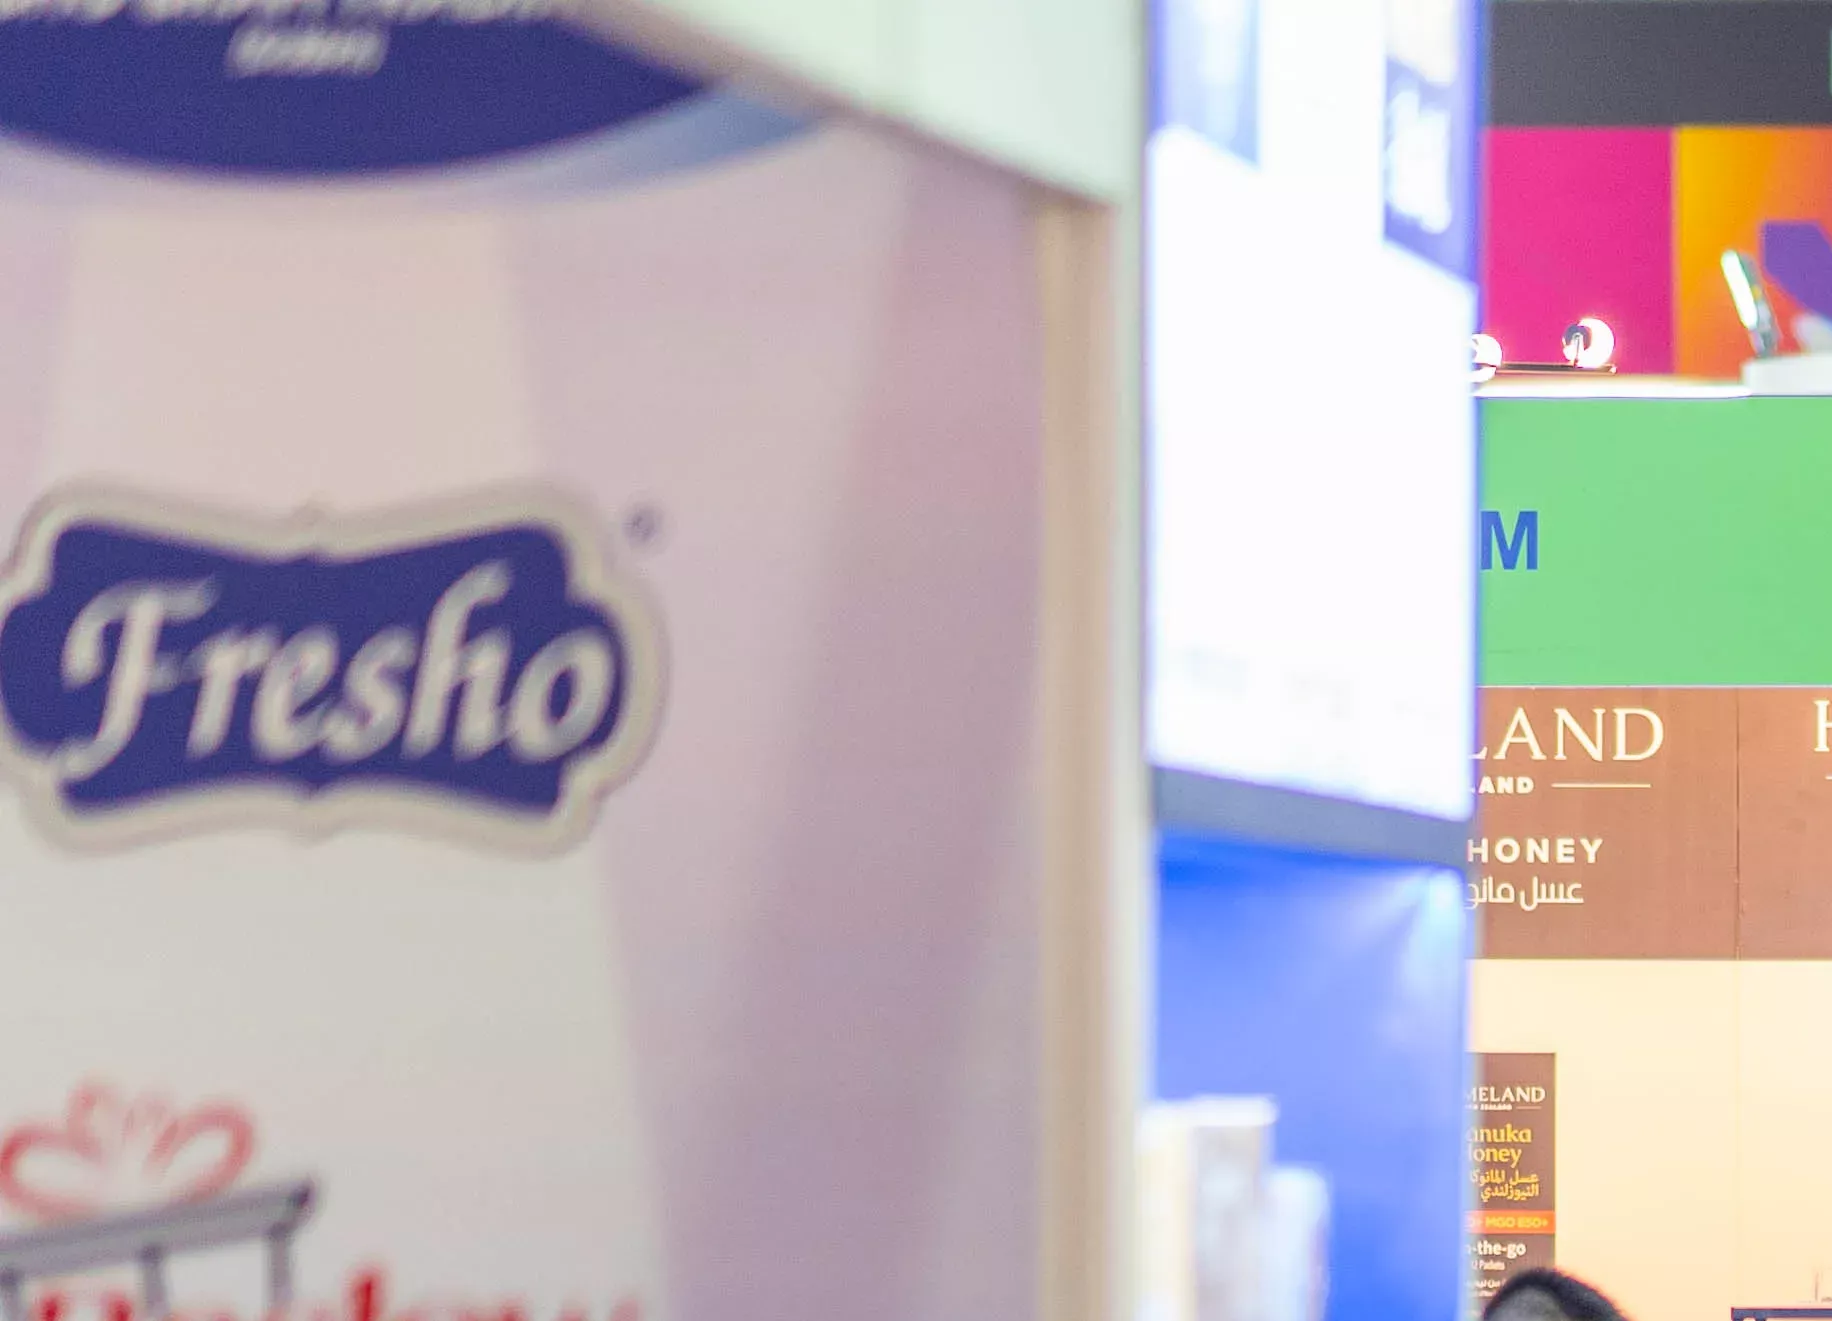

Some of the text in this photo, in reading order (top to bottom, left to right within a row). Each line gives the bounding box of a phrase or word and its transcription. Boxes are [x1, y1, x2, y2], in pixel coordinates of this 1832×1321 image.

[60, 558, 618, 781] Fresho
[1469, 706, 1665, 762] AND
[1471, 776, 1535, 794] AND
[1466, 837, 1604, 864] HONEY
[1466, 875, 1585, 912] عسل مانو
[1466, 1123, 1532, 1143] anuka
